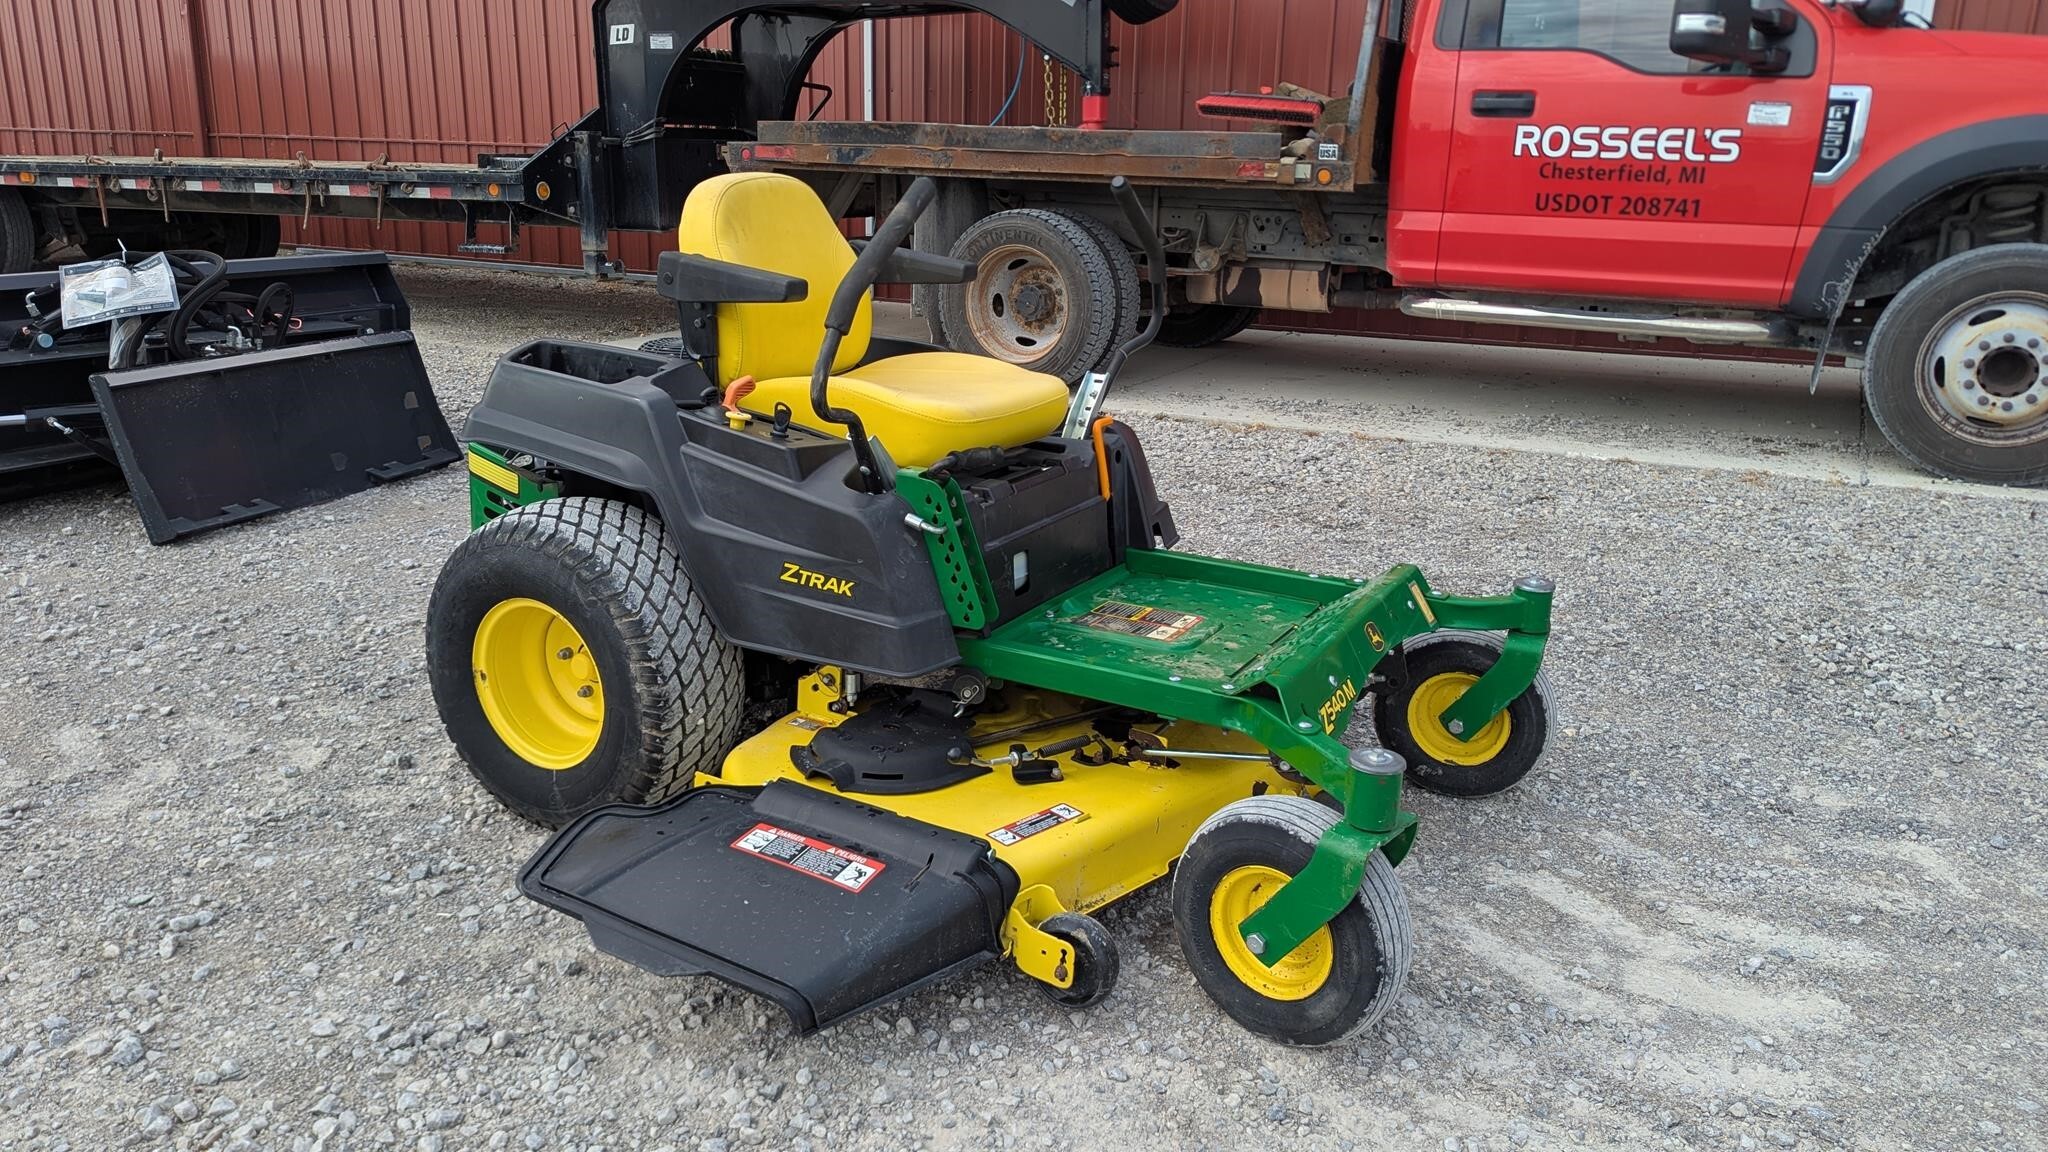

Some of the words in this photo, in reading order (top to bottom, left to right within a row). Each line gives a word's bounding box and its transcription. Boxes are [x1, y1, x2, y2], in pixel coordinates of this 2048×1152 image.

[616, 27, 629, 41] LD
[1513, 124, 1742, 163] ROSSEEL'S
[1319, 149, 1337, 159] USA
[1539, 162, 1671, 185] Chesterfield,
[1678, 167, 1706, 184] MI
[1535, 193, 1613, 214] USDOT
[1619, 195, 1702, 218] 208741
[780, 562, 856, 597] ZTRAK
[777, 829, 807, 843] DANGER
[834, 848, 868, 864] PELIGRO
